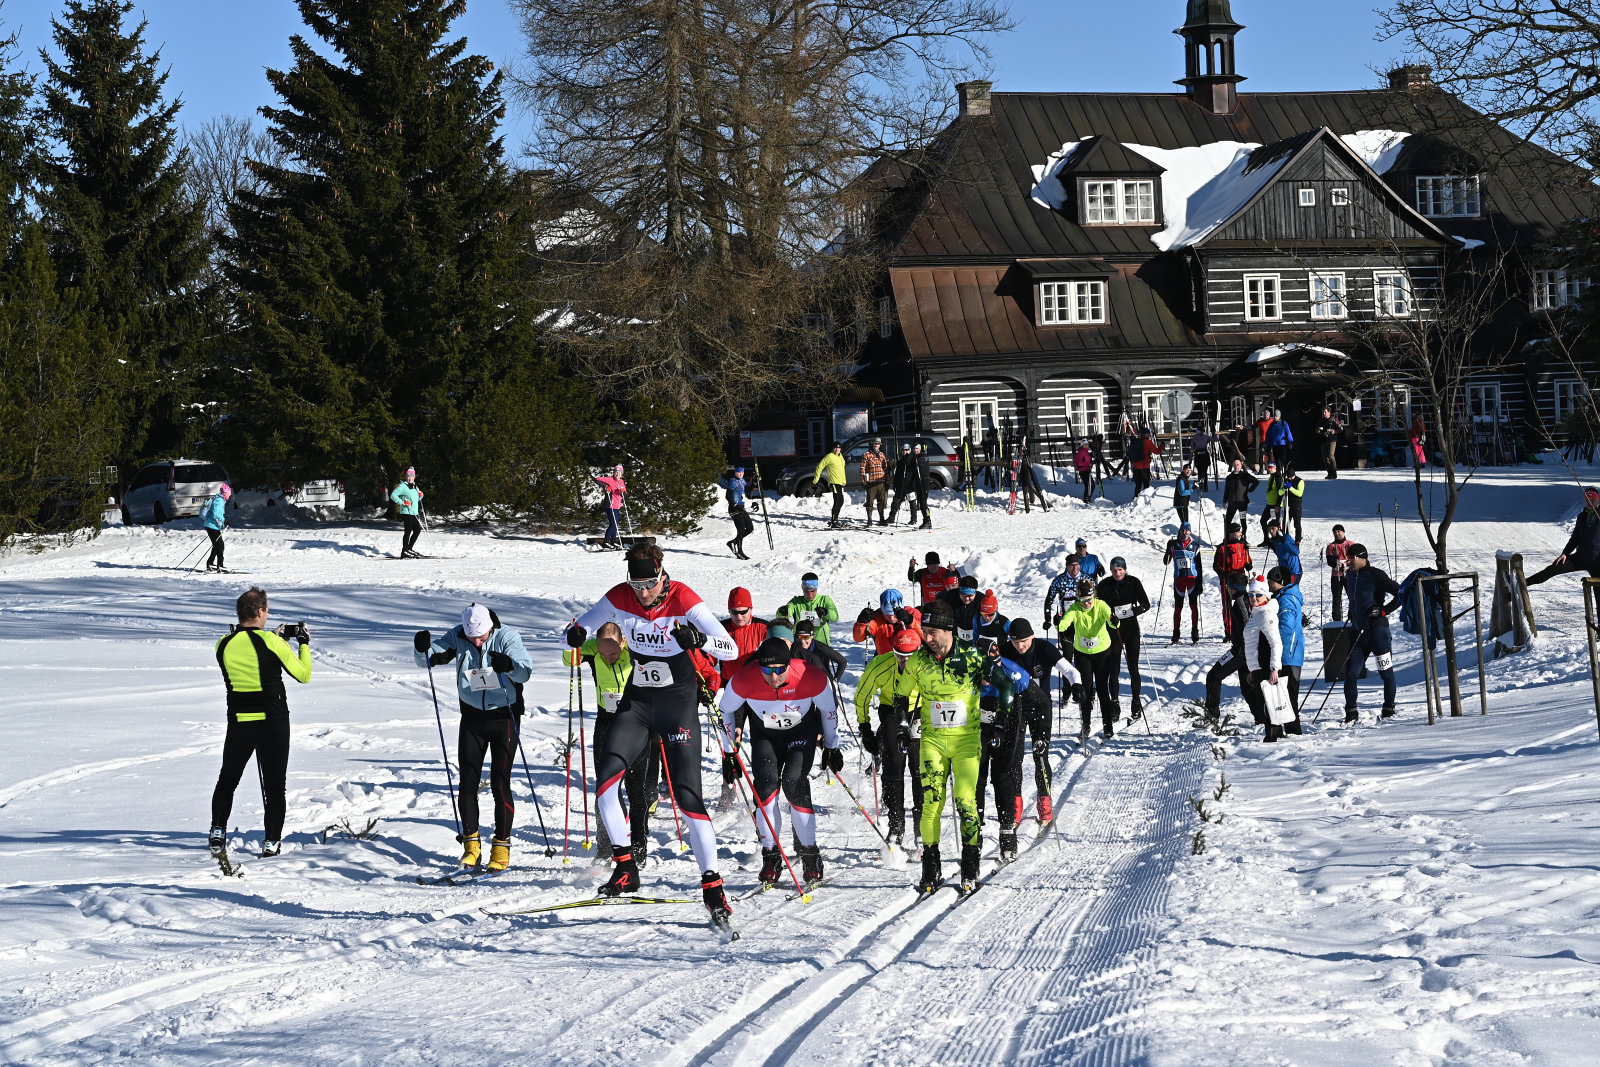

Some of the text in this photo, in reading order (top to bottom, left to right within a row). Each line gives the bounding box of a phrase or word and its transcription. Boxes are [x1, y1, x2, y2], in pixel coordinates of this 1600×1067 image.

[631, 628, 665, 645] lawi
[1377, 657, 1390, 667] 106
[479, 675, 487, 685] 1
[641, 669, 661, 682] 16
[939, 710, 956, 722] 17
[775, 718, 793, 728] 13
[667, 731, 688, 742] lawi
